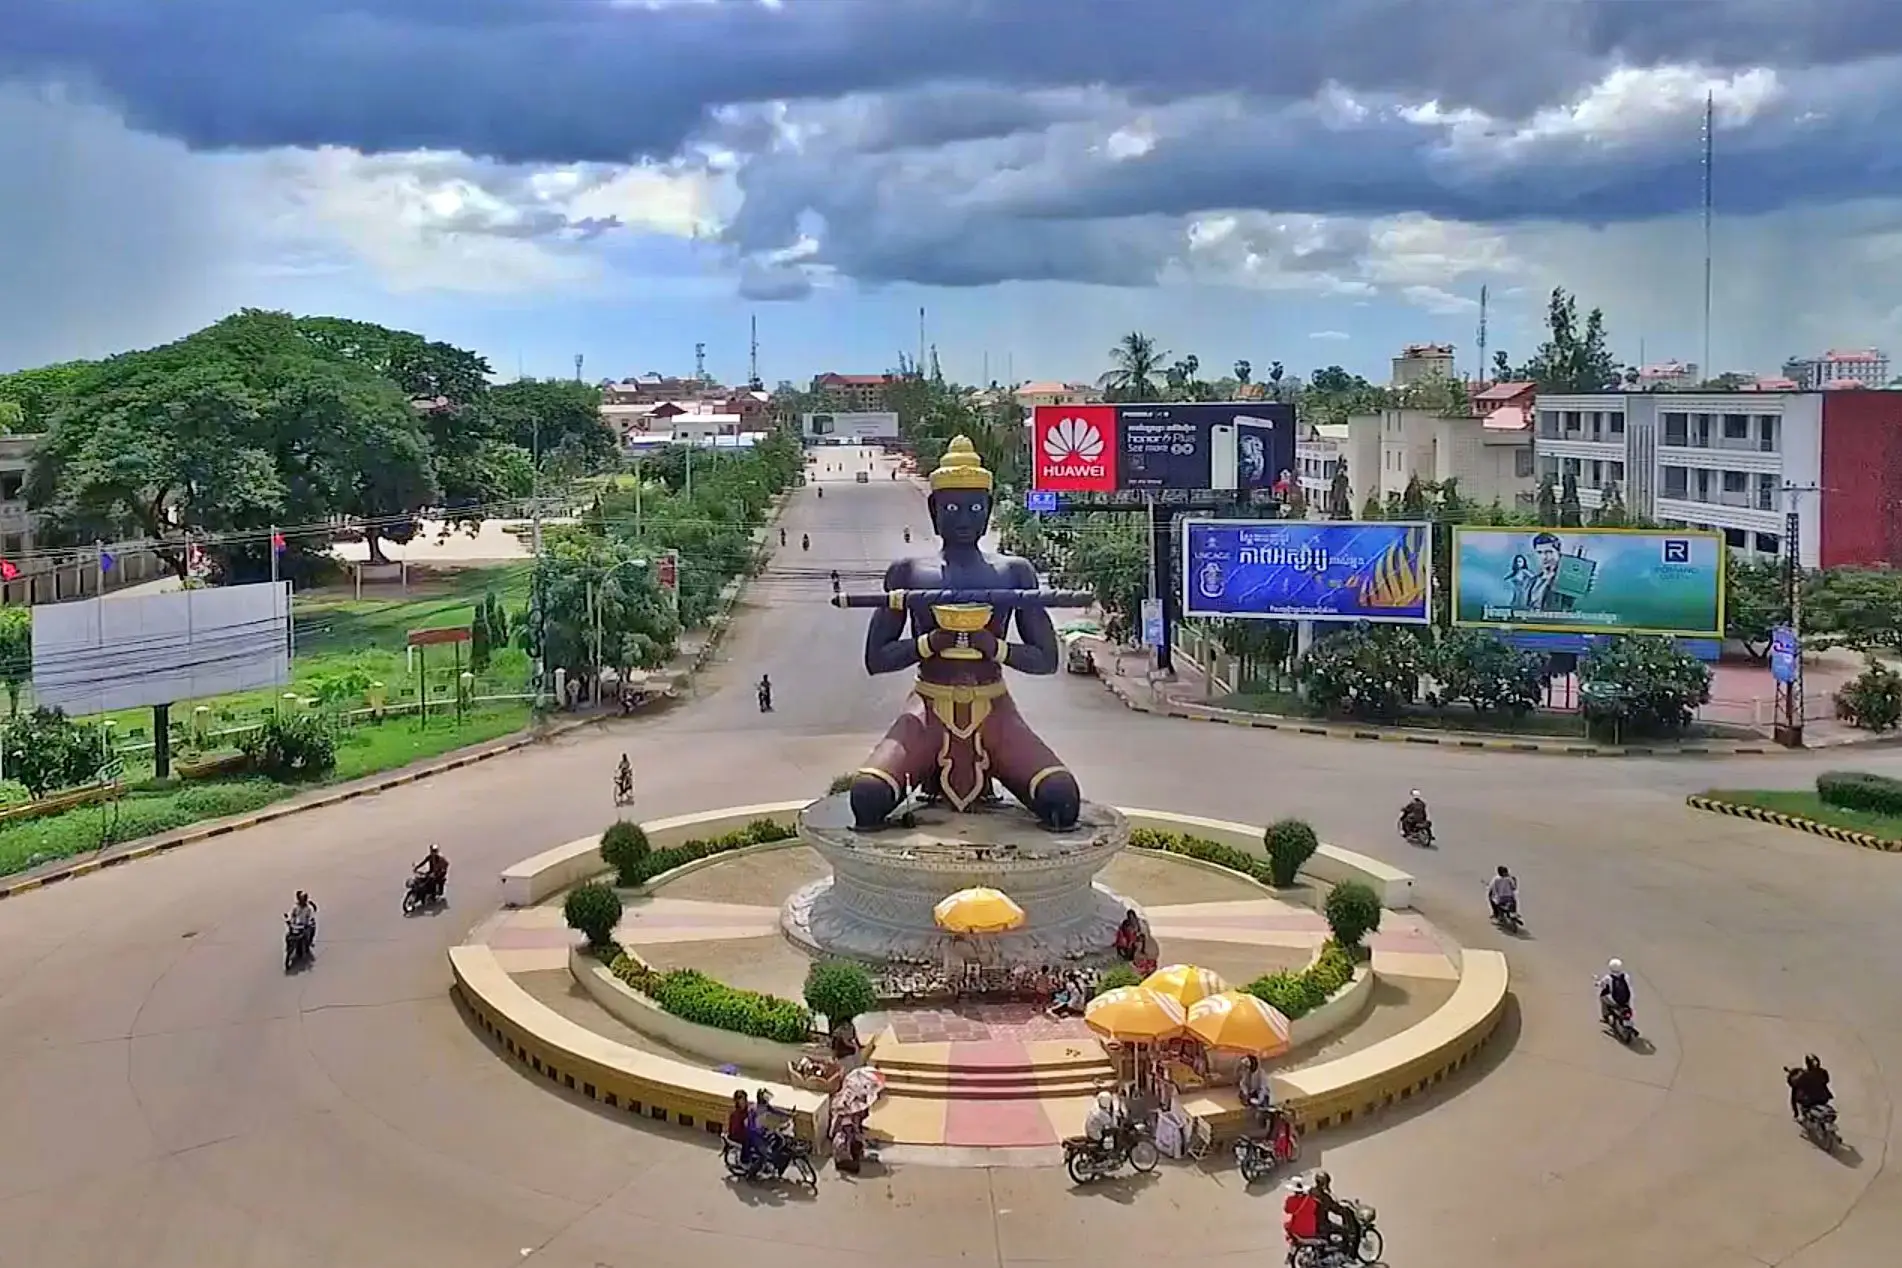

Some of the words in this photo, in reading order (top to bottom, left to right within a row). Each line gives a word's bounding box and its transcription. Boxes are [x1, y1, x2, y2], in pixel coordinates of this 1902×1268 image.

[1127, 432, 1162, 443] honor
[1172, 432, 1197, 444] Plus
[1043, 465, 1105, 477] HUAWEI
[1668, 543, 1685, 558] R
